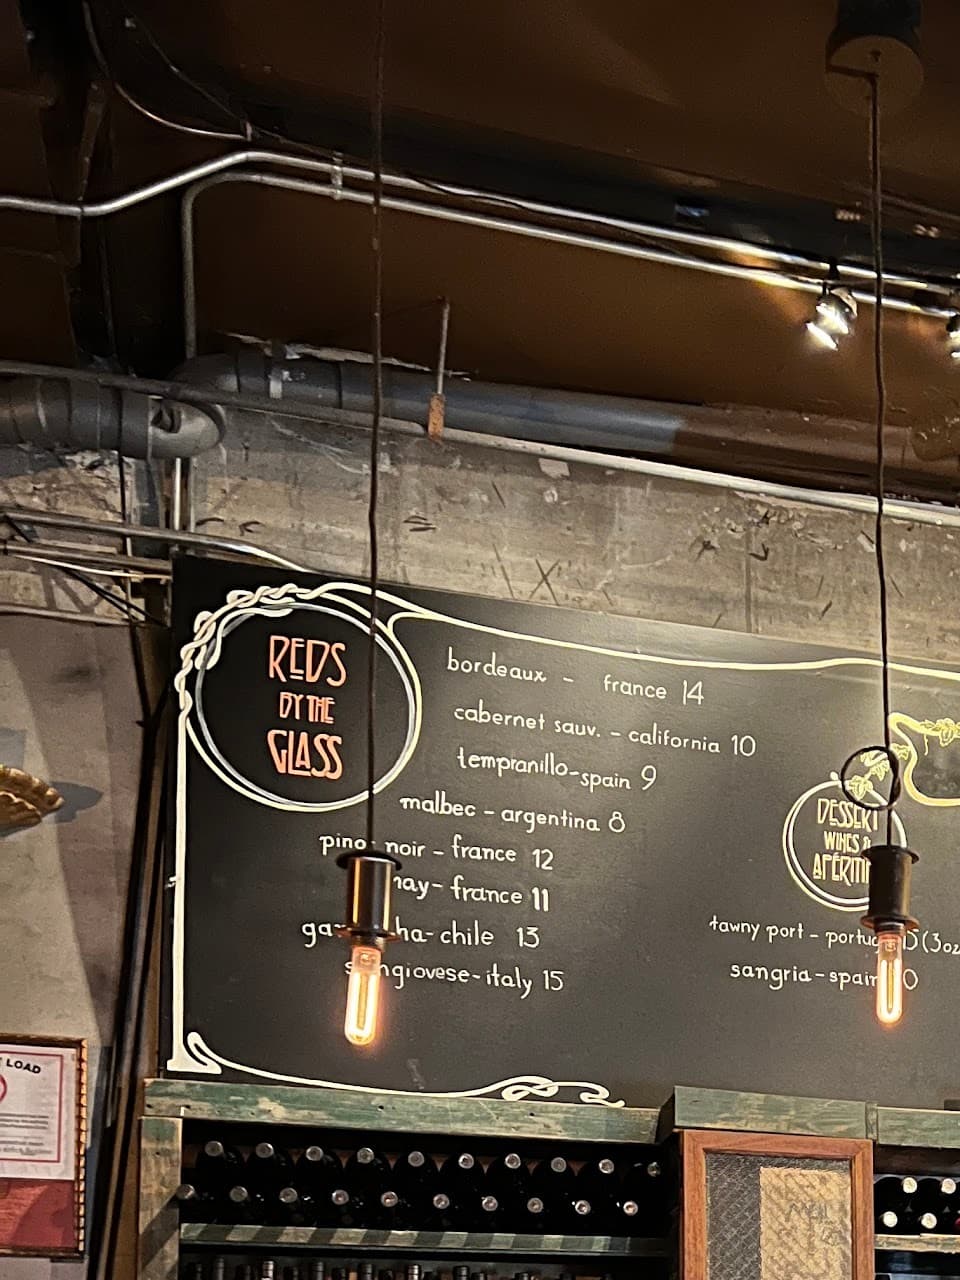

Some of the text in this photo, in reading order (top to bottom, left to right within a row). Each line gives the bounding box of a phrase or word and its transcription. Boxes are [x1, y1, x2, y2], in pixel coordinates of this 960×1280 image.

[269, 635, 347, 687] REDS
[447, 646, 547, 683] bordeaux
[603, 674, 667, 699] france
[682, 680, 704, 705] 14
[279, 691, 336, 724] BY THE
[454, 699, 545, 730] cabernet
[628, 723, 721, 753] california
[731, 734, 756, 757] 10
[267, 729, 343, 780] GLASS
[640, 765, 658, 791] 9
[399, 791, 476, 817] malbec
[501, 808, 600, 833] argentina
[608, 811, 626, 833] 8
[319, 833, 376, 856] pino
[384, 838, 426, 858] noir
[450, 833, 517, 862] france
[531, 848, 554, 870] 12
[824, 830, 860, 853] WINES
[450, 874, 522, 904] france
[530, 887, 550, 912] 11
[516, 927, 540, 949] 13
[709, 915, 761, 941] tawny
[766, 922, 804, 943] port
[542, 970, 565, 991] 15
[6, 1058, 42, 1075] LOAD
